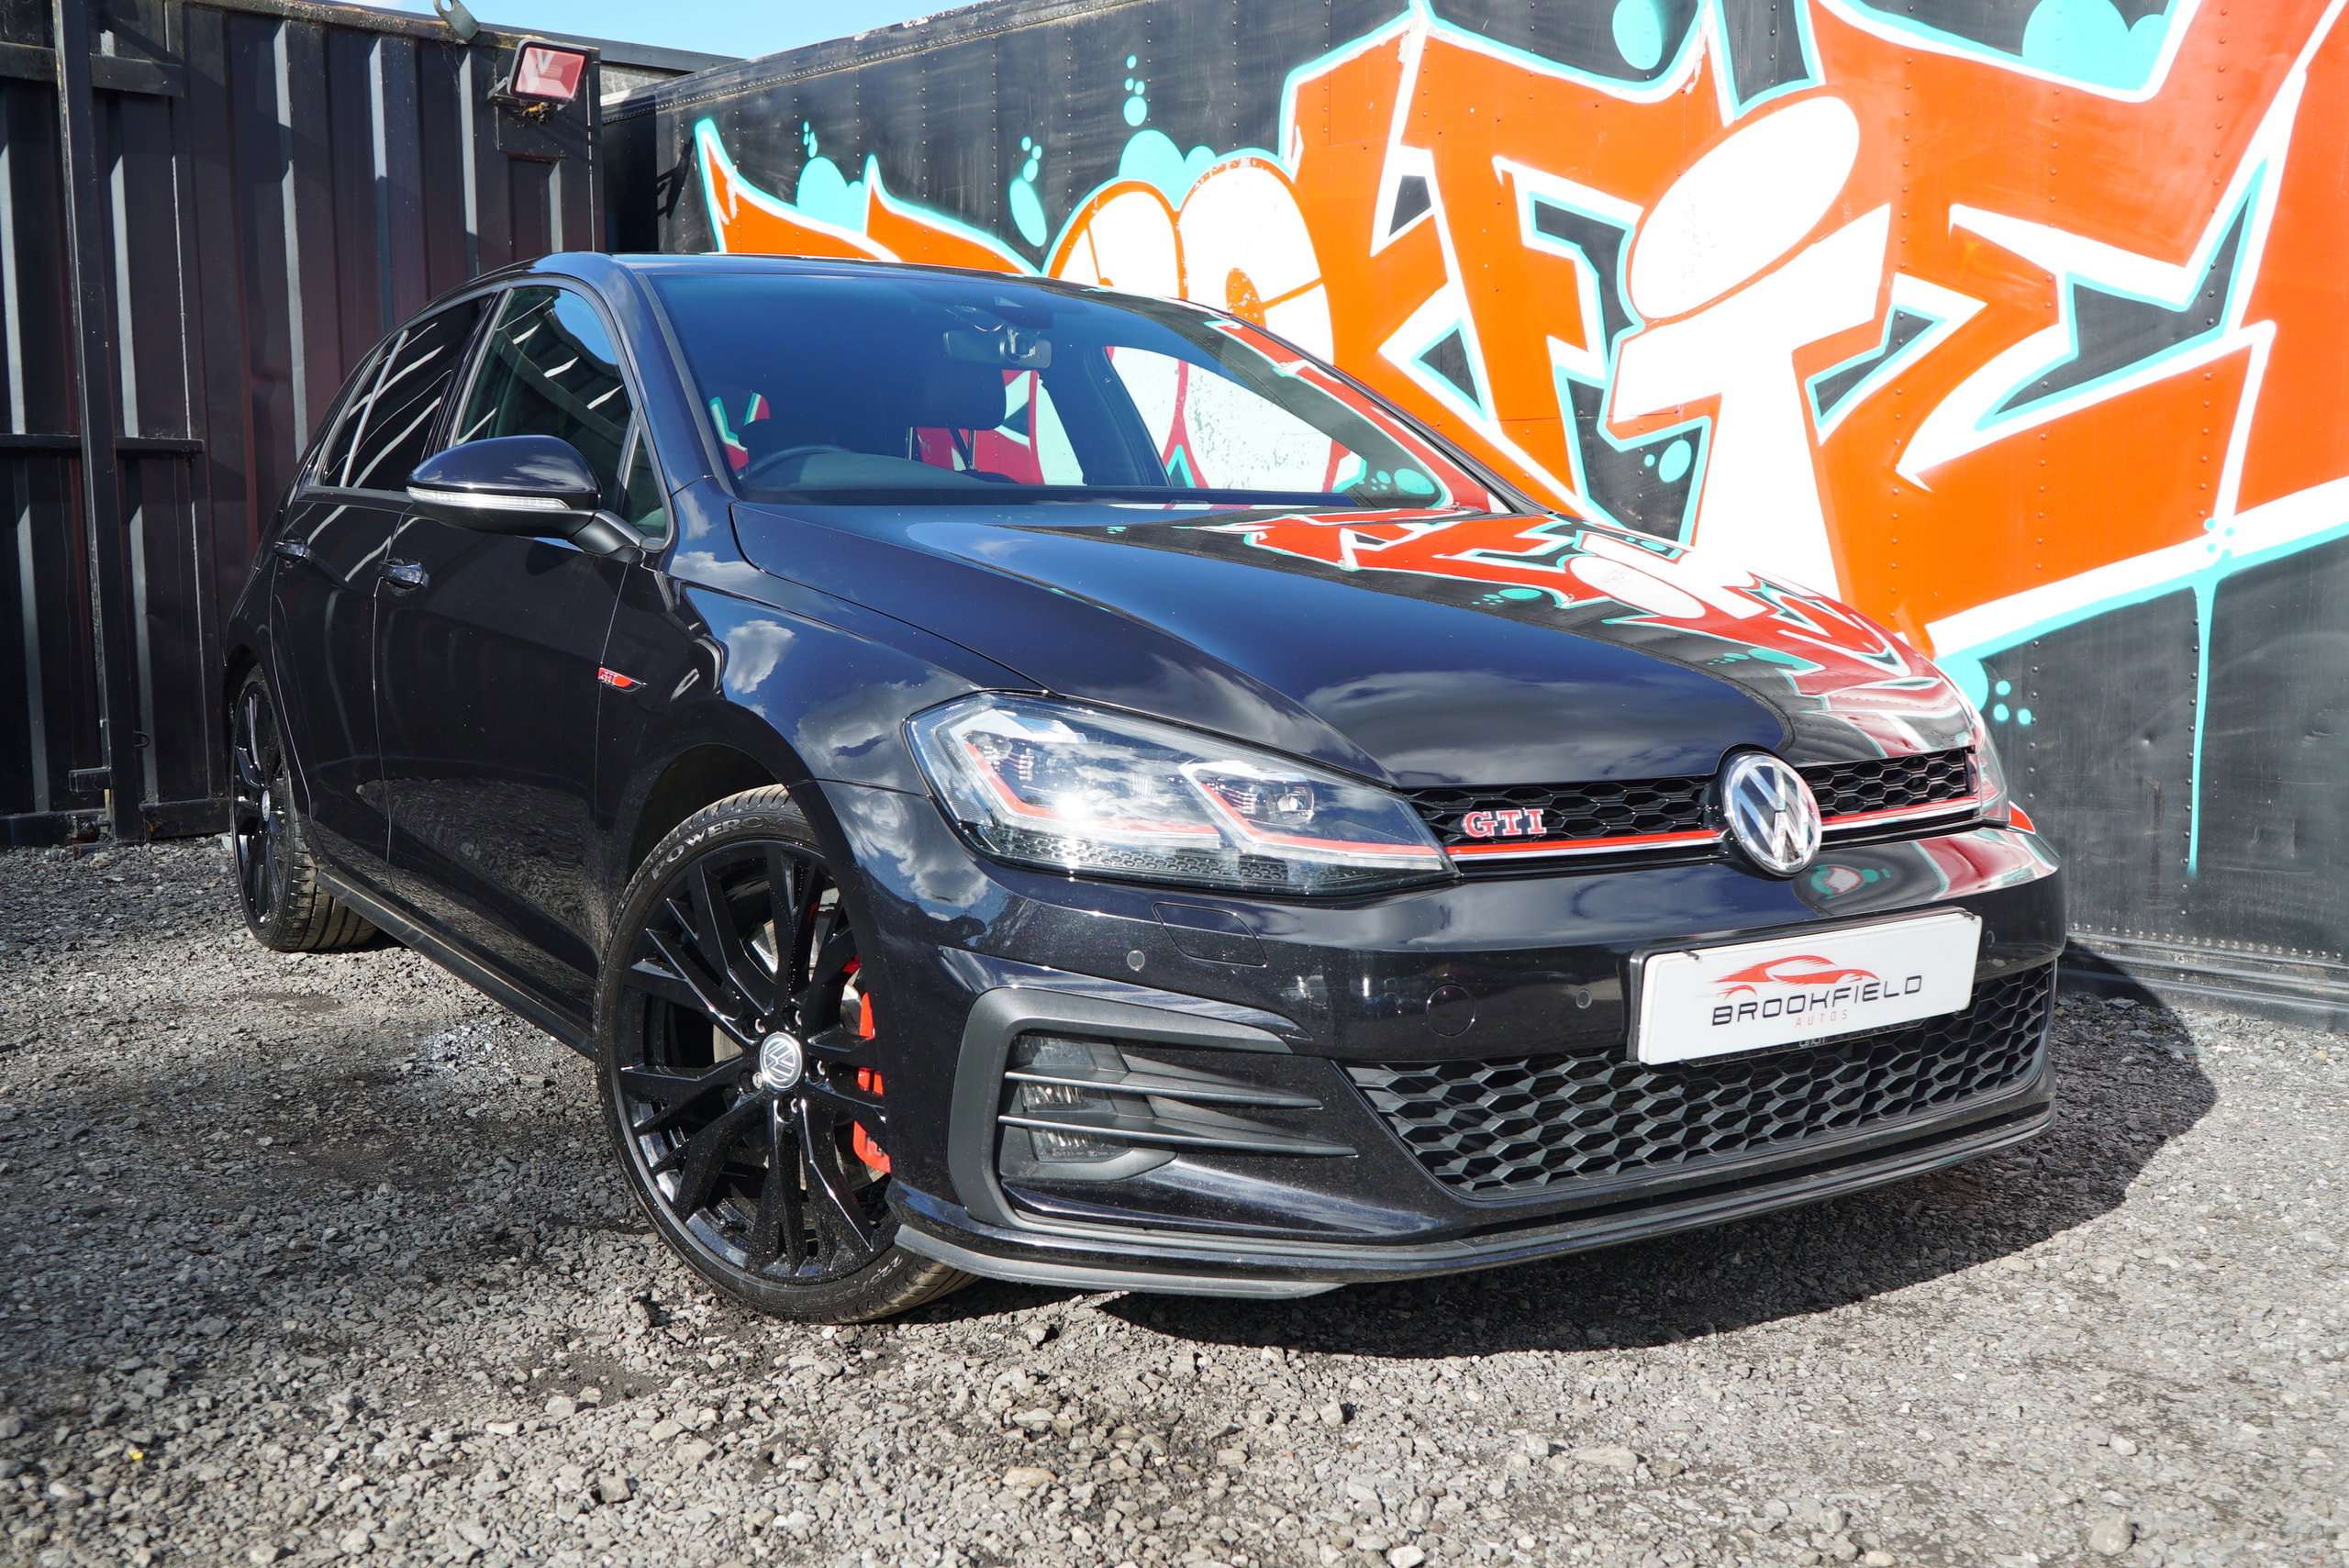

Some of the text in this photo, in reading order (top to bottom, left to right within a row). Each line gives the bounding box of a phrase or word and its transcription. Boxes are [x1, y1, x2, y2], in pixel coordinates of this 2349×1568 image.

[1461, 807, 1548, 839] GTI
[1711, 974, 1923, 1027] BROOKFIELD
[1794, 1009, 1849, 1028] AUTOS
